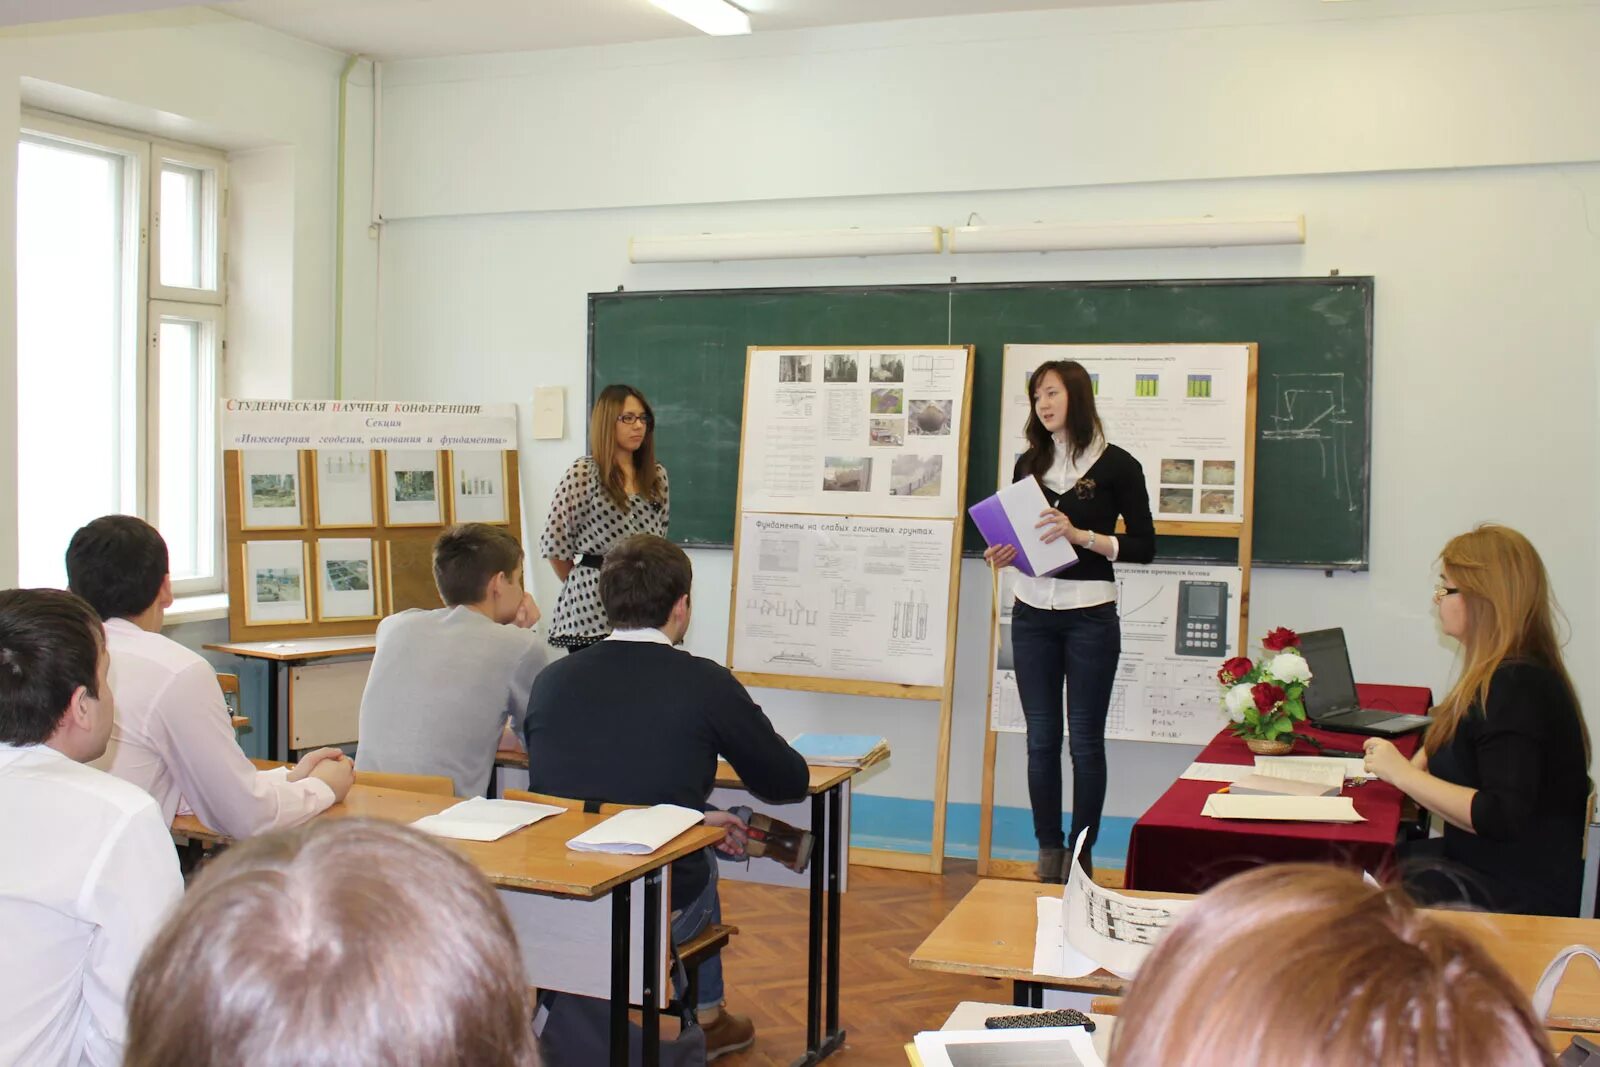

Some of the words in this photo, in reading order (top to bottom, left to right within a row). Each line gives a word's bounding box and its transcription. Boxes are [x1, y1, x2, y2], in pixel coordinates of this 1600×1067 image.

[226, 399, 327, 412] СТУДЕНЧЕСКАЯ
[332, 402, 389, 413] НАУЧНАЯ
[394, 402, 481, 414] КОНФЕРЕНЦИЯ
[365, 417, 402, 429] Секция
[235, 433, 311, 446] «Инженерная
[318, 435, 365, 445] геодезия,
[370, 435, 422, 444] основания
[426, 436, 433, 444] и
[439, 434, 508, 446] фундаменты»
[755, 520, 804, 531] Фундаменты
[807, 523, 817, 531] на
[820, 522, 849, 532] слабых
[852, 525, 894, 534] глинистых
